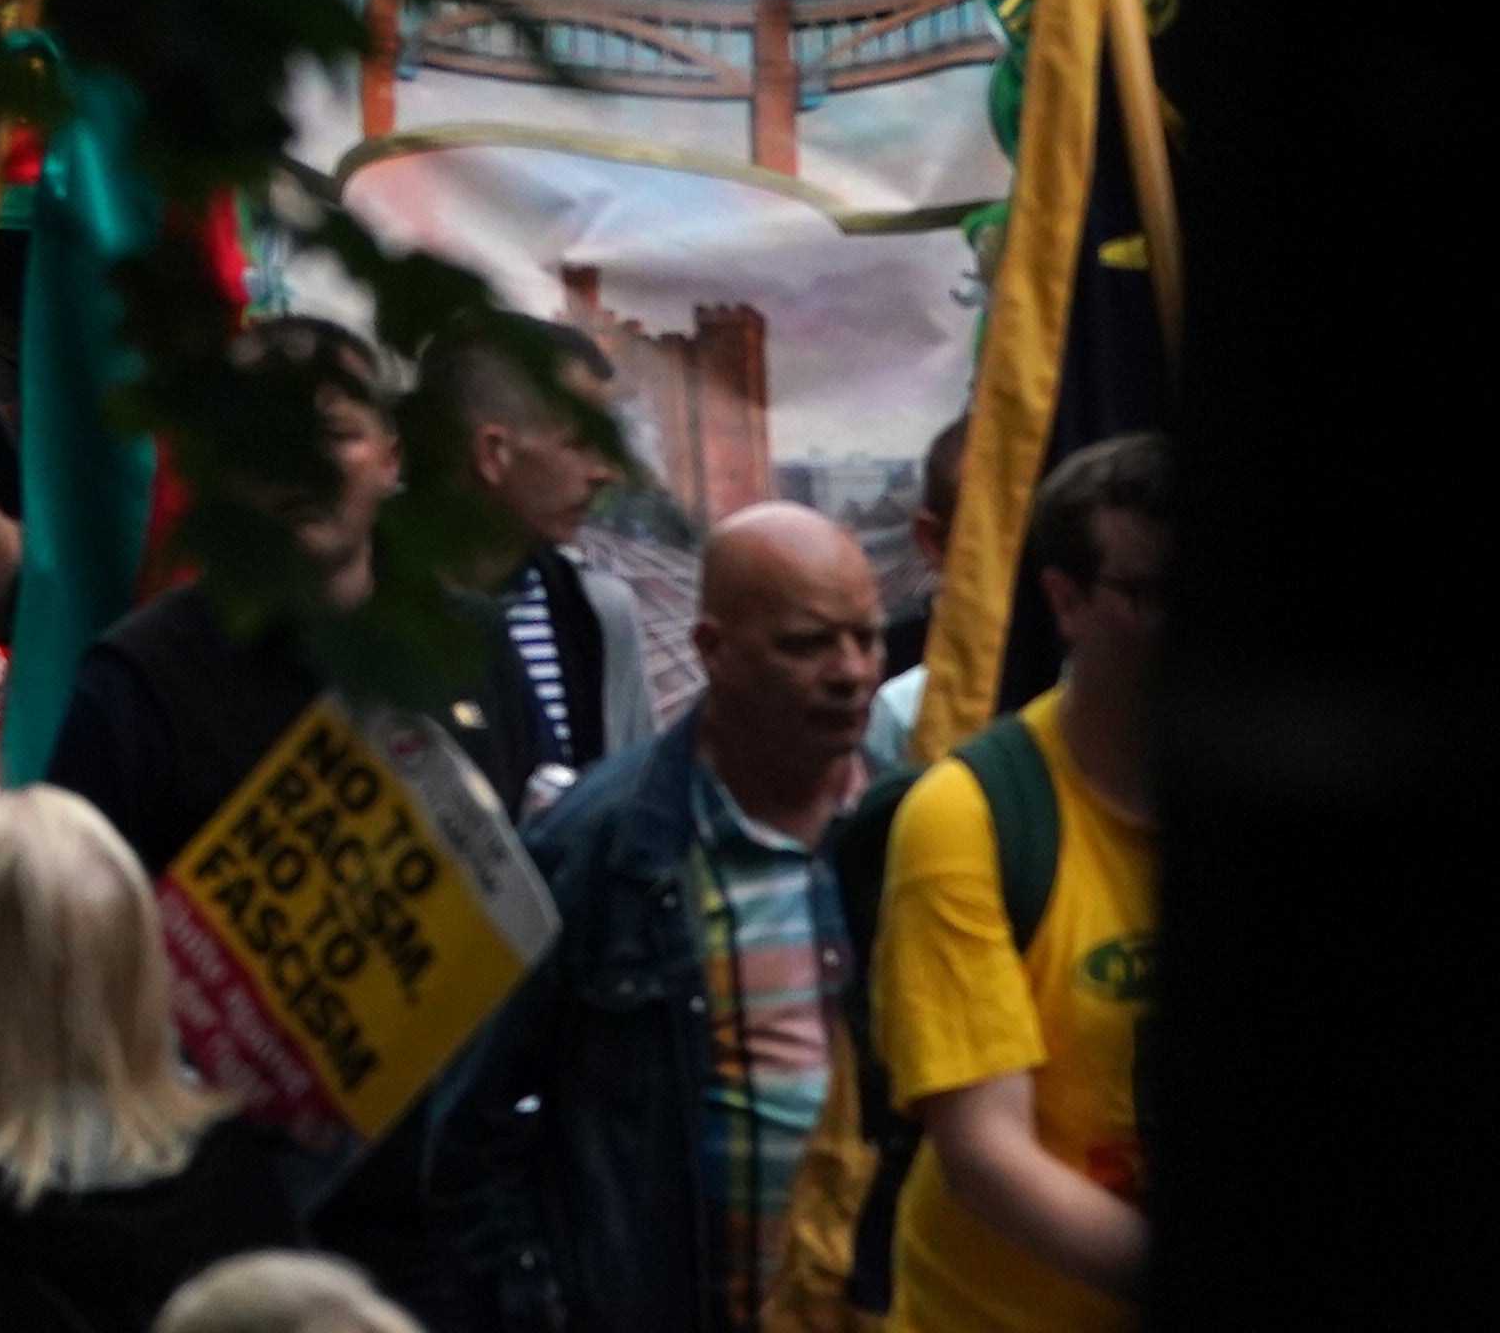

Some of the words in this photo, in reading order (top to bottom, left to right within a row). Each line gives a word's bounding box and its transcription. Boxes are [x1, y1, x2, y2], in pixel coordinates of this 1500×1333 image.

[233, 806, 308, 894] NO
[305, 891, 367, 980] TO
[300, 727, 380, 814] NO
[377, 803, 440, 896] TO
